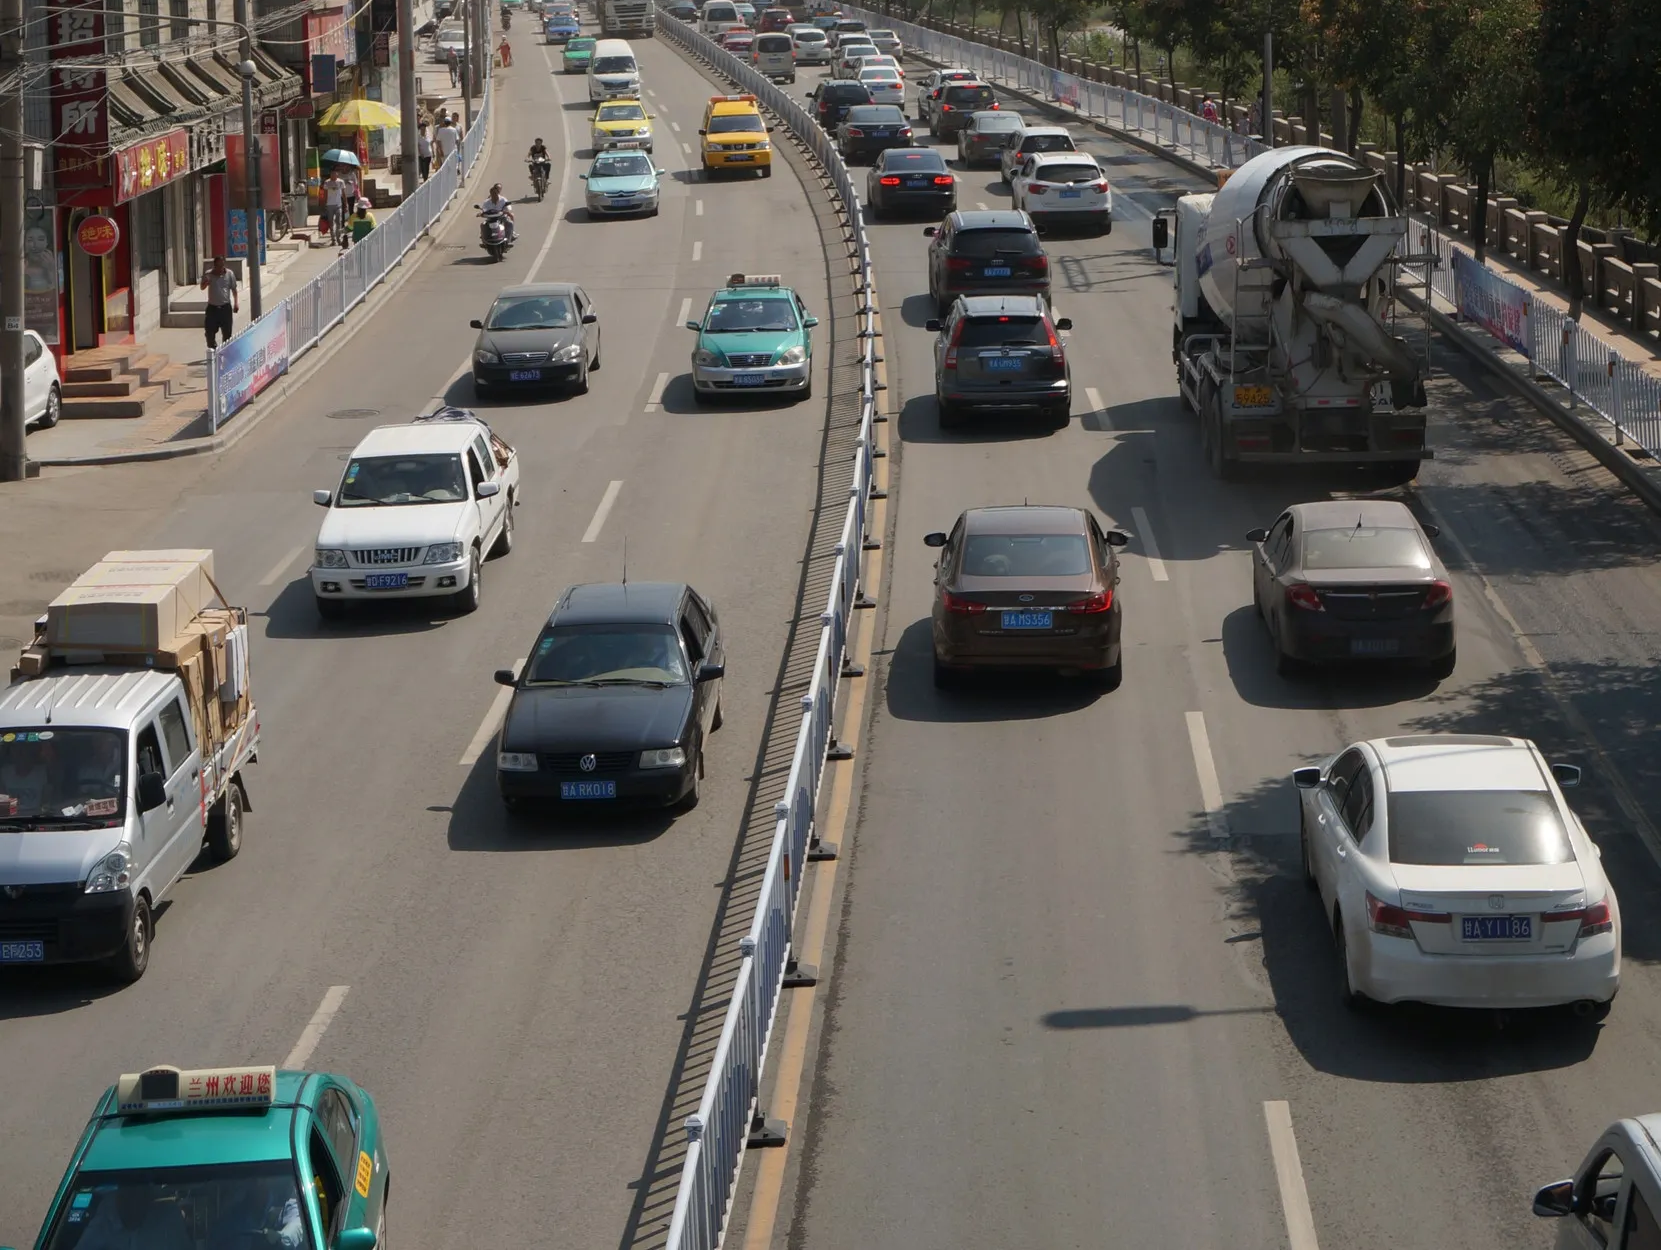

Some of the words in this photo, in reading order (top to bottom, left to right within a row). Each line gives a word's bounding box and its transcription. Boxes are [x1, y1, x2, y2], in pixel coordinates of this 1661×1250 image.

[188, 1072, 271, 1098] 兰州欢迎您
